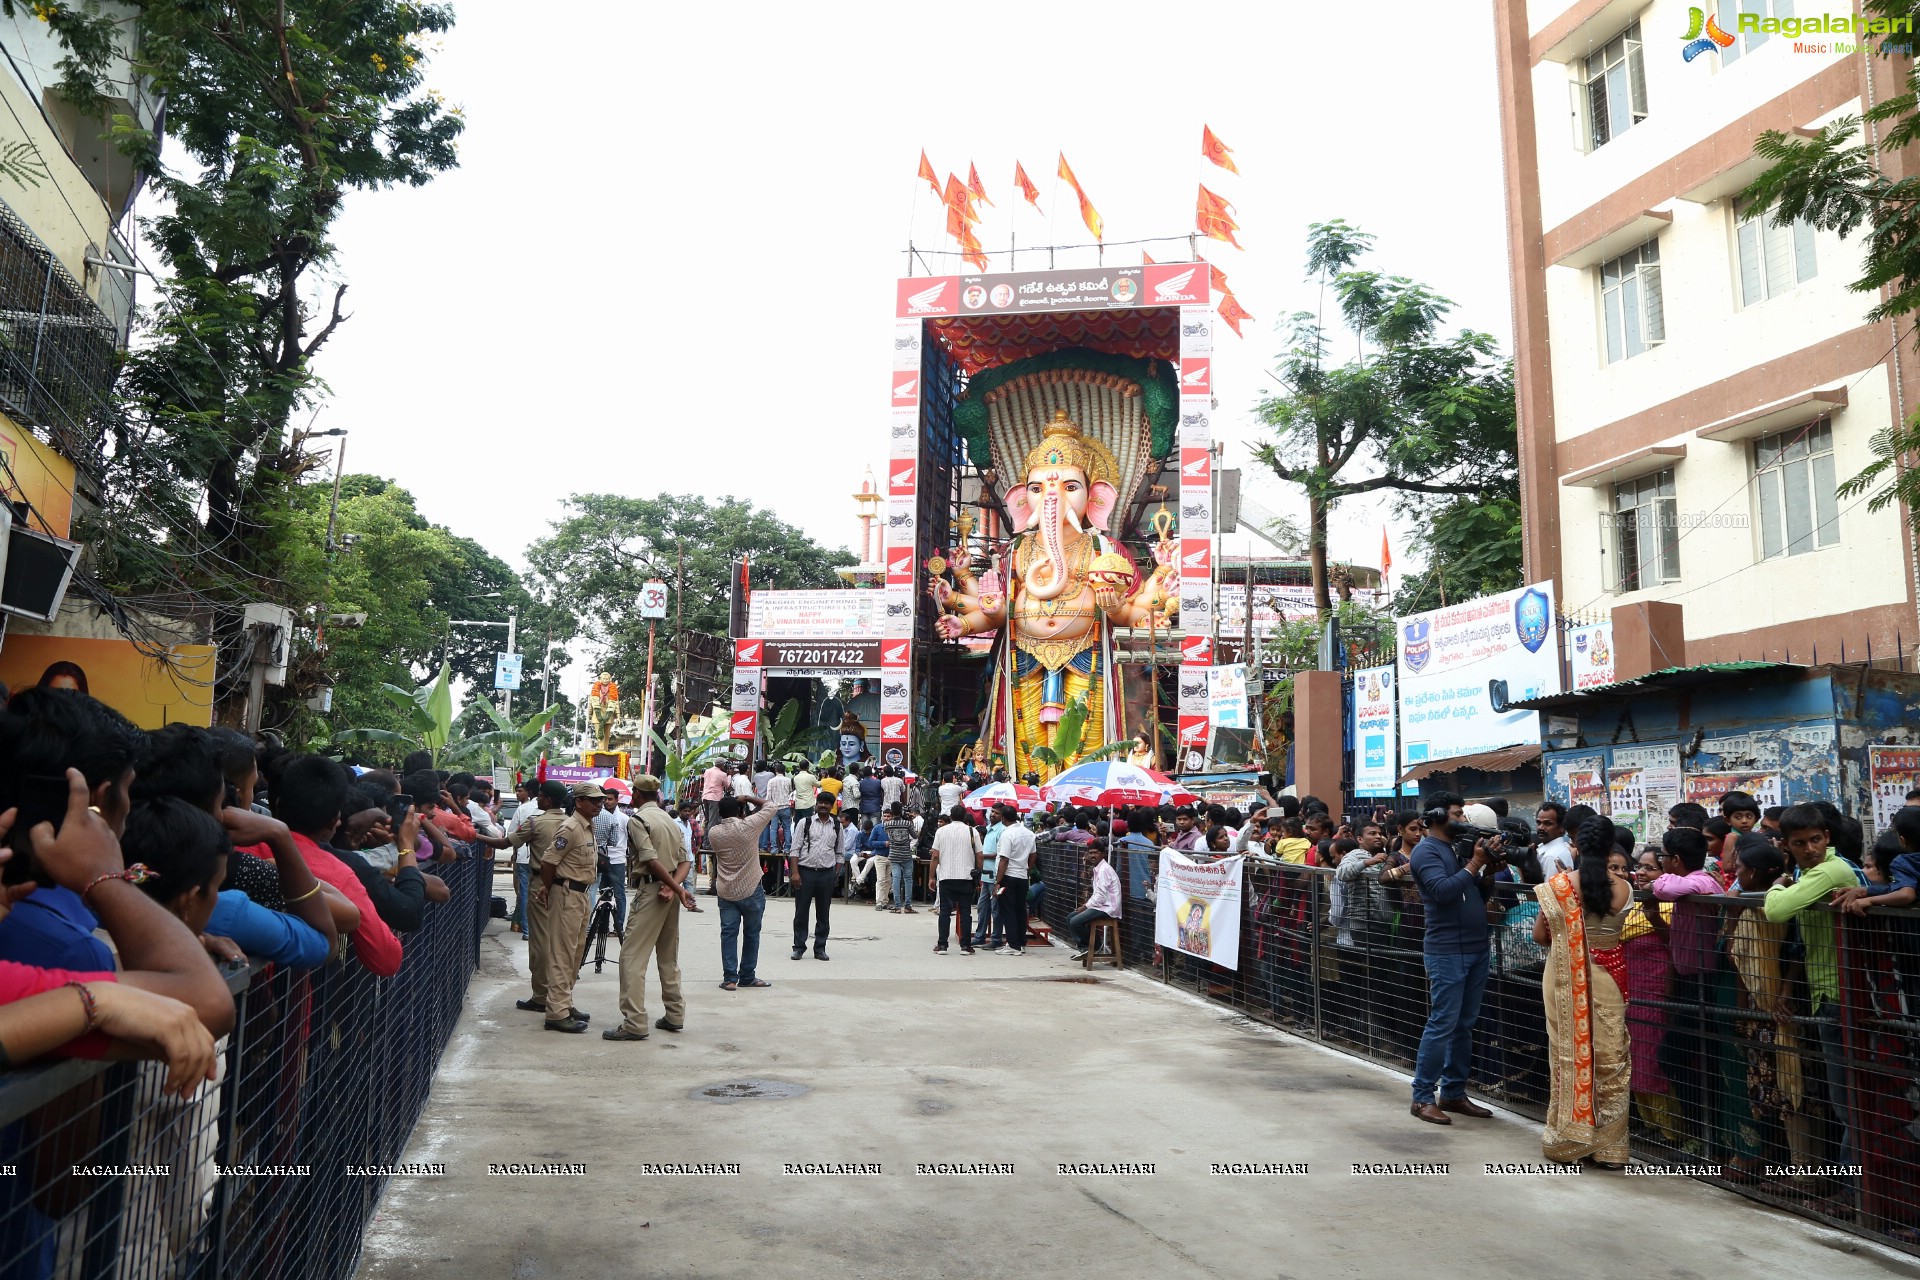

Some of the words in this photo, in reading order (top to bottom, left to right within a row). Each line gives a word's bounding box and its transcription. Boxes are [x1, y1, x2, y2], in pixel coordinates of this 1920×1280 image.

[1079, 277, 1108, 290] కమిటీ
[1155, 294, 1197, 302] HONDA
[908, 306, 948, 314] HONDA
[1521, 606, 1542, 616] POLICE
[1406, 642, 1429, 654] POLICE
[779, 650, 864, 663] 7672017422
[1405, 696, 1414, 705] ఈ
[1415, 691, 1440, 707] ప్రదేశం
[1428, 705, 1450, 721] నీడలో
[1366, 745, 1385, 760] aegis
[1433, 747, 1453, 758] Aegis
